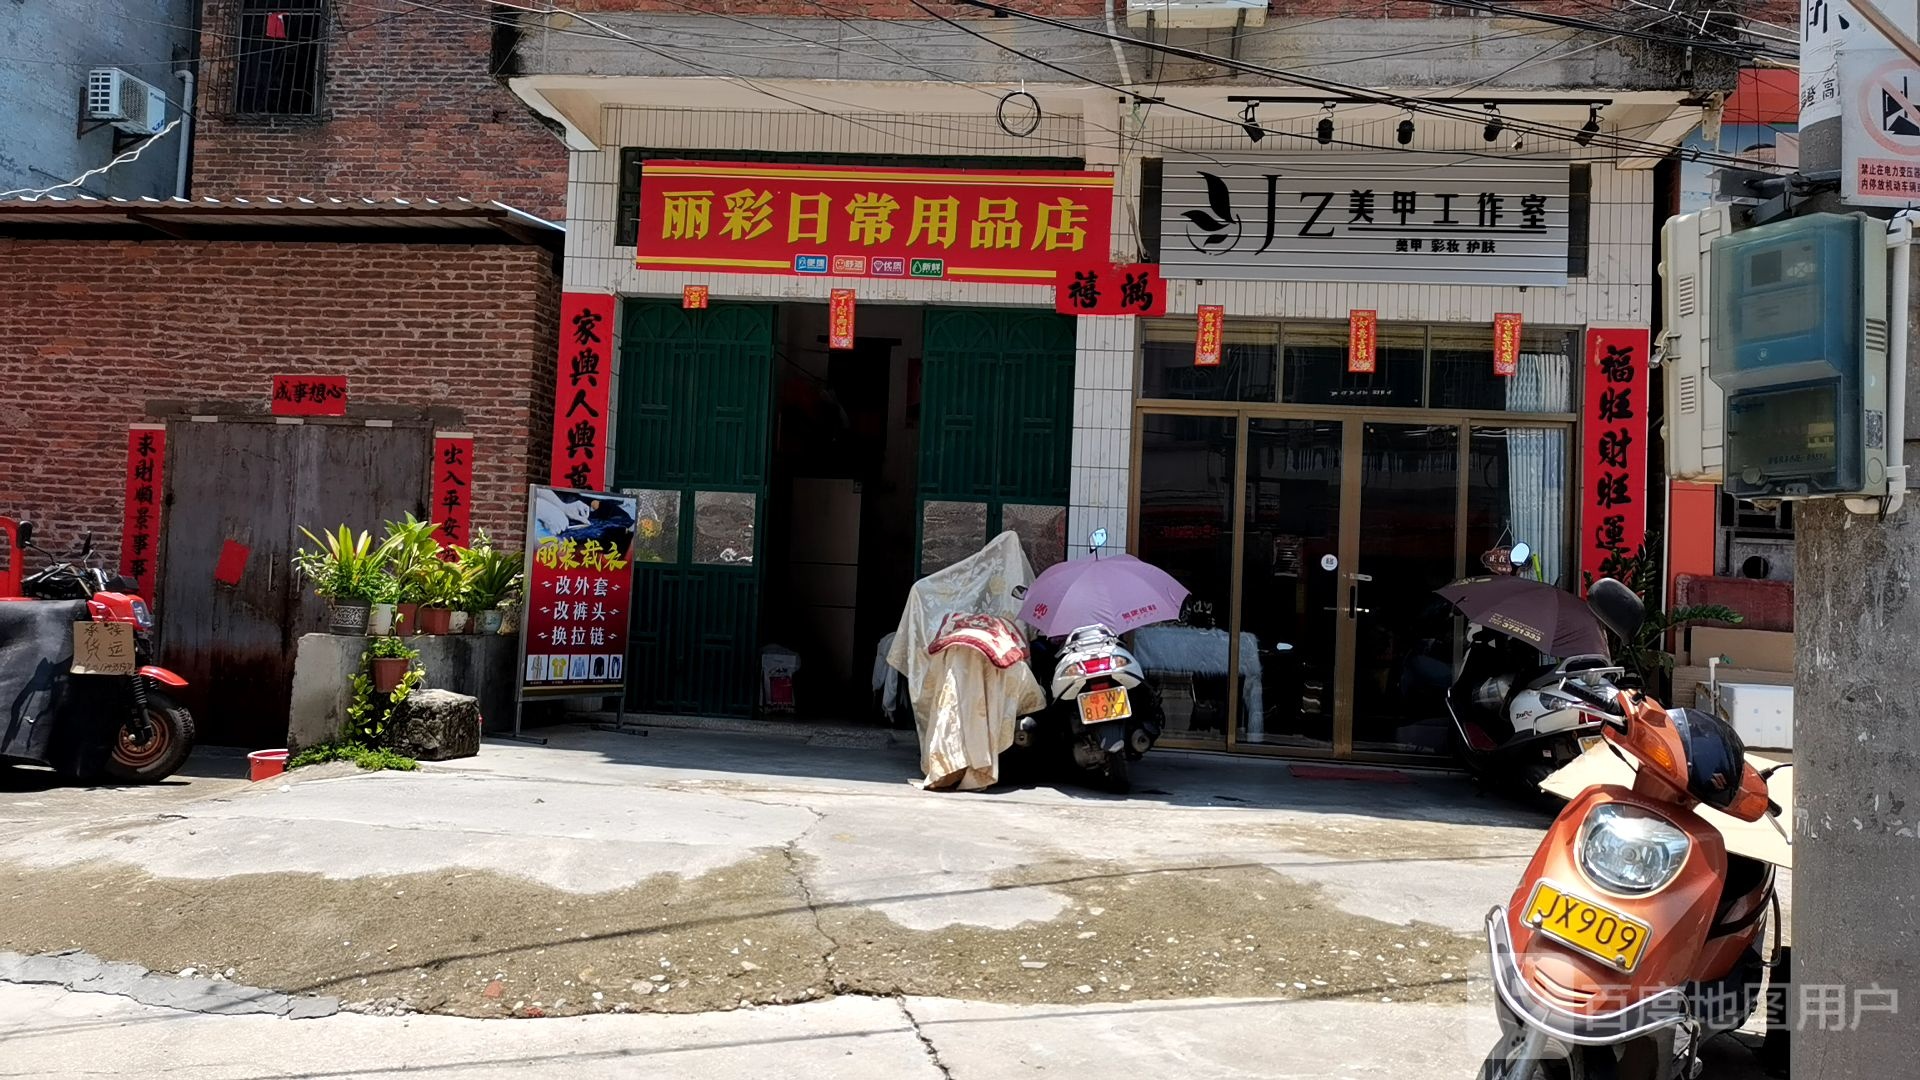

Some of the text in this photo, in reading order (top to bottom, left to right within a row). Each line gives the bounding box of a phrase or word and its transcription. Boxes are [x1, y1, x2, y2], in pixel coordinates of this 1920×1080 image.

[661, 188, 1089, 251] 丽彩日常用品店
[1348, 189, 1547, 229] 美甲工作室
[1396, 239, 1495, 253] 美甲 彩妆 护肤
[883, 260, 902, 271] 优质
[922, 262, 941, 272] 新鲜
[555, 575, 609, 597] 改外套
[553, 600, 606, 621] 改裤头
[551, 625, 605, 646] 换拉链
[1537, 894, 1638, 952] JX909
